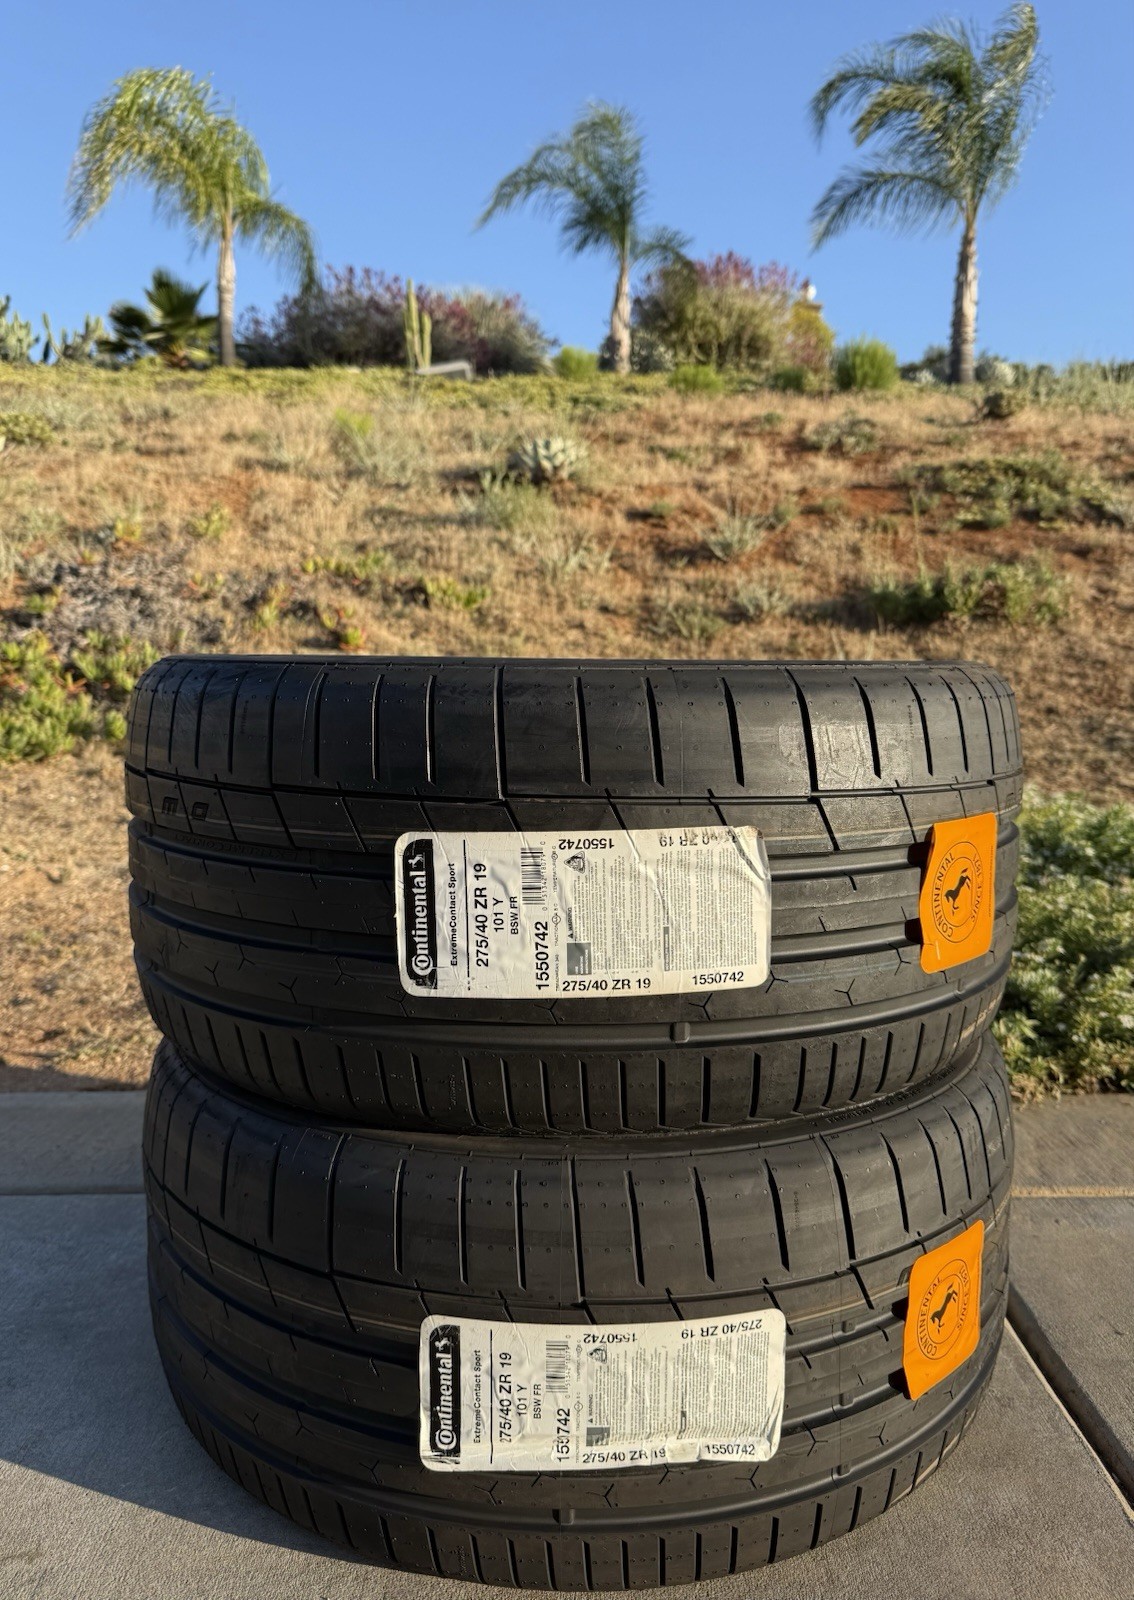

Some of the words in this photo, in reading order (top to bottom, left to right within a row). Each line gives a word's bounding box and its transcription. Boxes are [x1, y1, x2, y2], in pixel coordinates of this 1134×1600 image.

[558, 838, 615, 850] 1550742
[448, 863, 459, 890] Sport
[474, 863, 488, 881] 19
[474, 887, 488, 909] ZR
[492, 897, 505, 907] Y
[510, 896, 519, 909] FR
[933, 852, 956, 938] CONTINENTAL
[971, 885, 983, 923] SINCE
[409, 870, 433, 976] Continental
[448, 891, 458, 967] ExtremeContact
[493, 912, 505, 933] 101
[510, 911, 519, 935] BSW
[475, 914, 489, 968] 275/40
[534, 921, 550, 991] 1550742
[562, 980, 608, 992] 275/40
[611, 979, 632, 990] ZR
[635, 977, 651, 989] 19
[692, 971, 744, 986] 1550742
[919, 1277, 943, 1356] CONTINENTAL
[956, 1292, 970, 1331] SINCE
[681, 1329, 695, 1339] 19
[700, 1325, 717, 1337] ZR
[721, 1318, 763, 1334] 275/40
[583, 1332, 637, 1344] 1550742
[474, 1350, 484, 1375] Sport
[499, 1352, 512, 1368] 19
[499, 1373, 512, 1394] ZR
[516, 1384, 528, 1393] Y
[533, 1383, 542, 1396] FR
[435, 1354, 458, 1450] Continental
[473, 1375, 482, 1443] ExtremeContact
[517, 1398, 528, 1417] 101
[533, 1398, 542, 1419] BSW
[499, 1398, 512, 1443] 275/40
[582, 1452, 626, 1464] 275/40
[705, 1444, 755, 1456] 1550742
